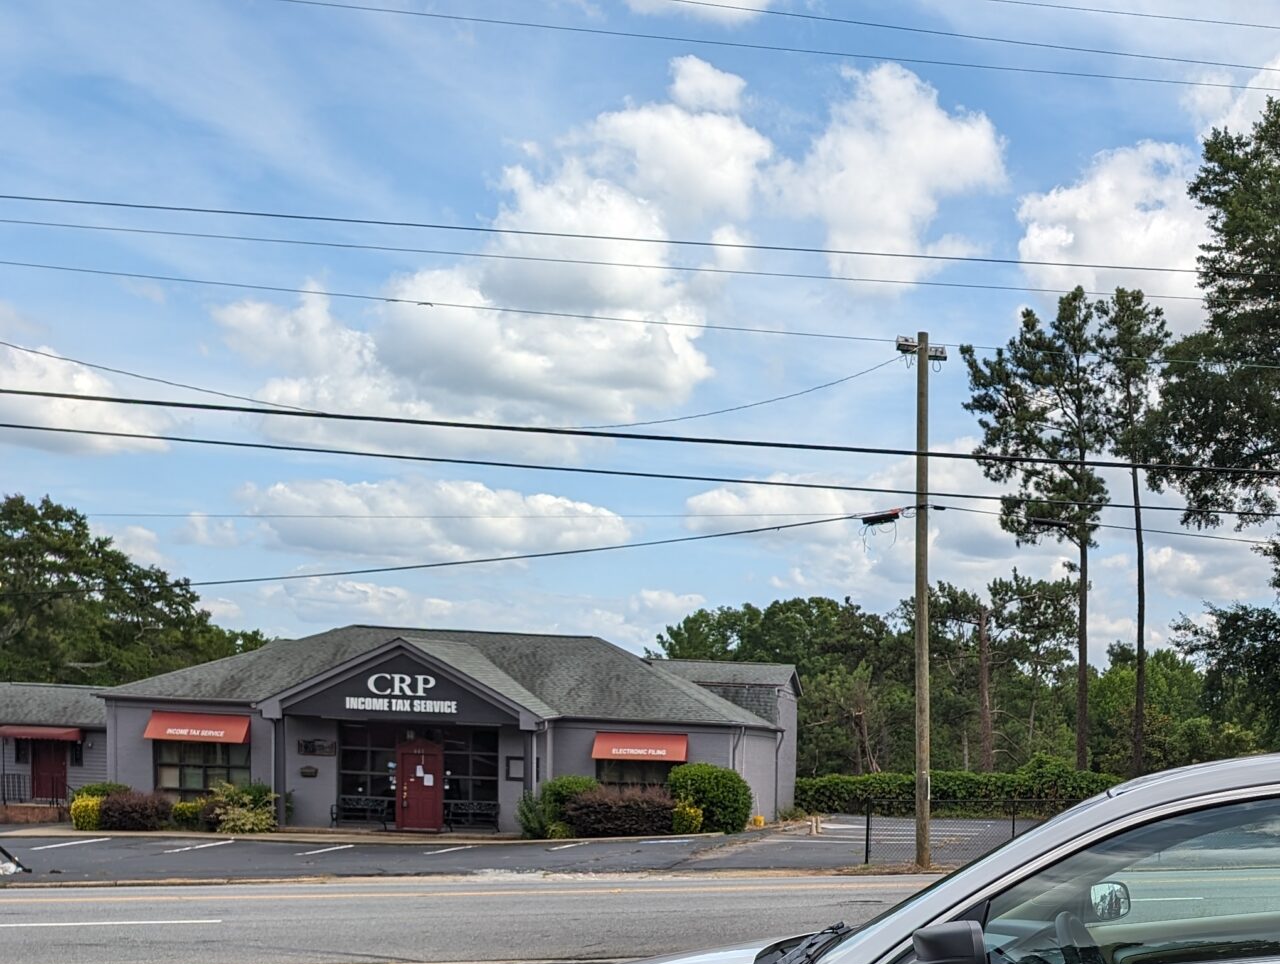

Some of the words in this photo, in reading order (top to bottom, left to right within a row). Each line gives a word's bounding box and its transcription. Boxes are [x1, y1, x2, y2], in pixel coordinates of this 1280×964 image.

[367, 673, 436, 696] CRP
[345, 696, 389, 711] INCOME
[391, 698, 411, 711] TAX
[413, 699, 457, 713] SERVICE
[166, 728, 189, 736] INCOME
